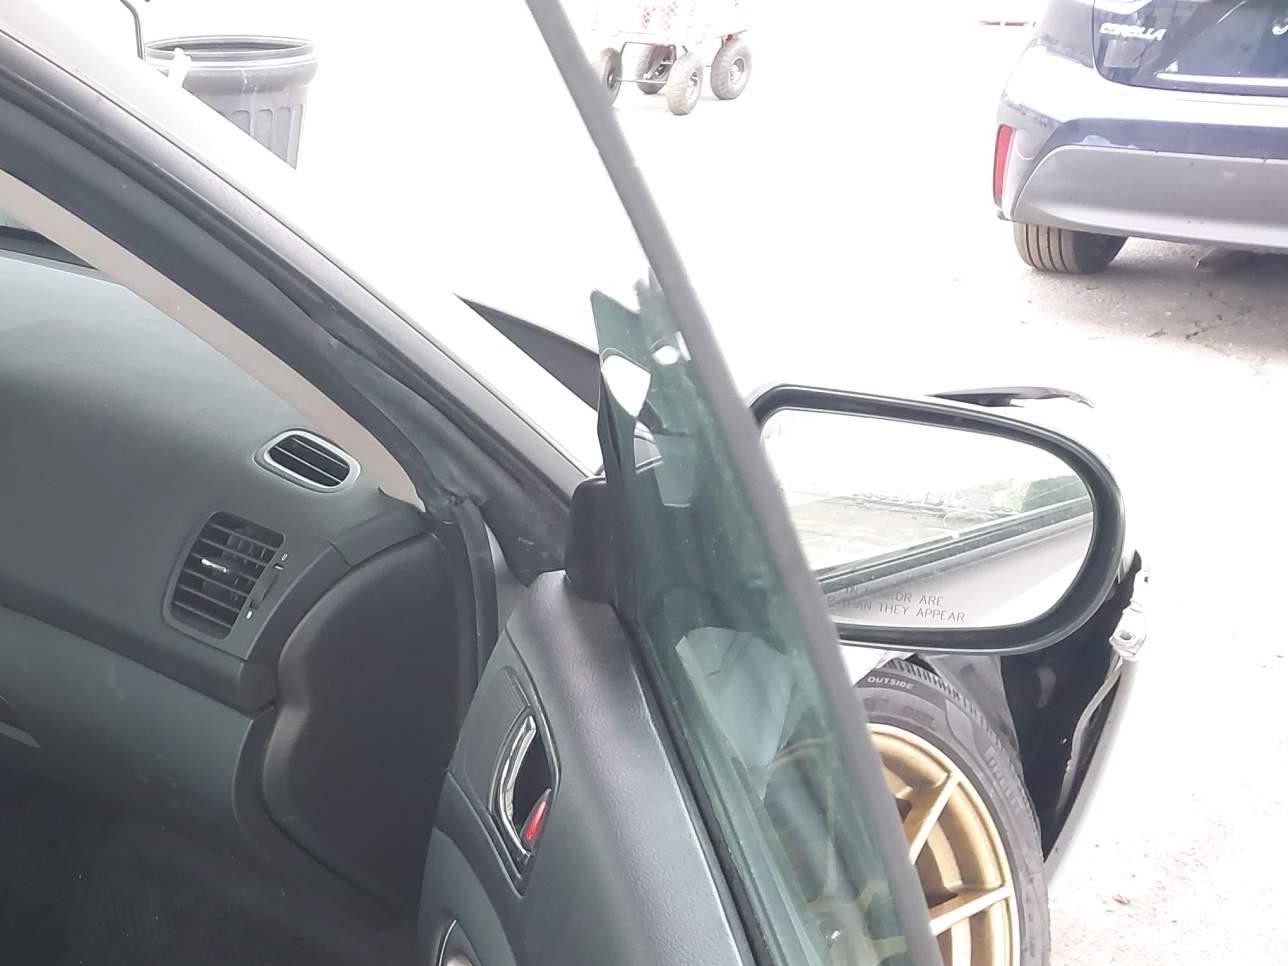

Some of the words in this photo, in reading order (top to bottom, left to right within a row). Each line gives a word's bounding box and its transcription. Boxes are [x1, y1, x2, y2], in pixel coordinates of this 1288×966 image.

[919, 594, 944, 607] ARE
[879, 602, 909, 615] THEY
[916, 607, 966, 623] APPEAR
[867, 676, 914, 690] OUTSIDE
